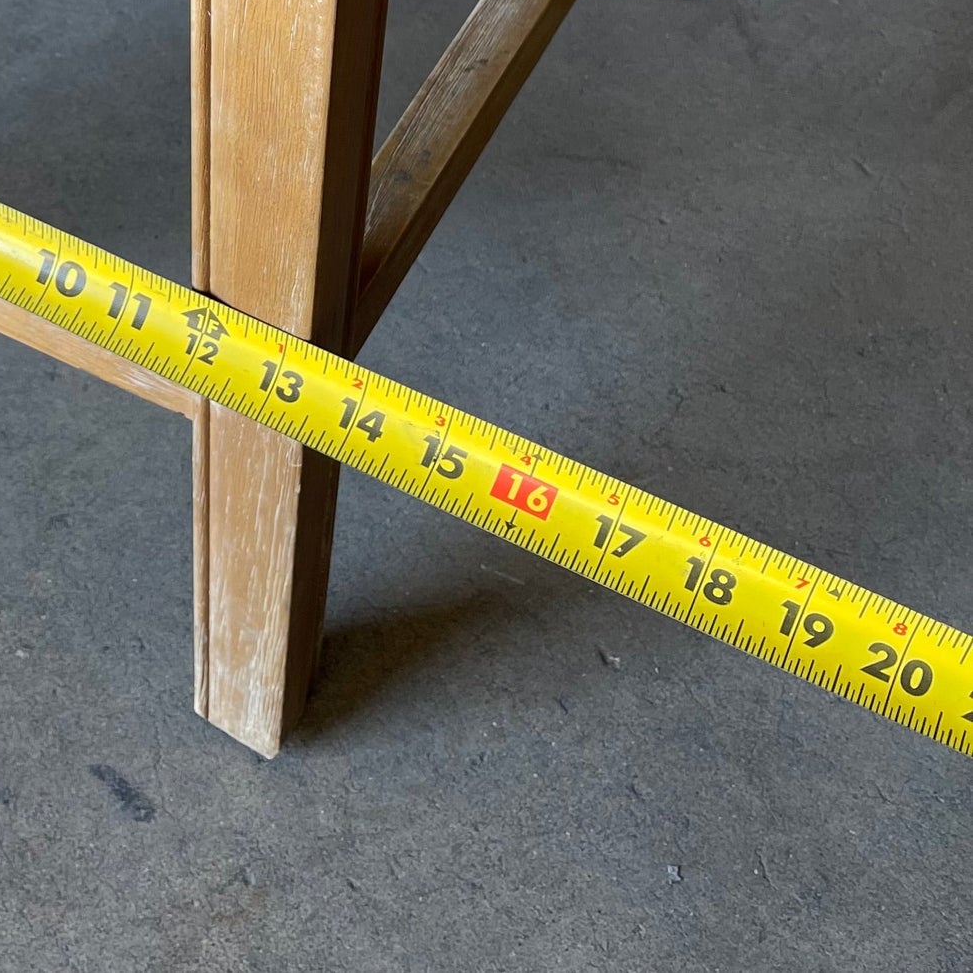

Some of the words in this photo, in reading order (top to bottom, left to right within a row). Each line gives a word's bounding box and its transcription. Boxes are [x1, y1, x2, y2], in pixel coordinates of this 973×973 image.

[36, 248, 87, 297] 10
[107, 282, 152, 331] 11
[185, 333, 219, 365] 12
[259, 360, 304, 403] 13
[339, 396, 386, 443] 14
[420, 435, 468, 479] 15
[504, 473, 549, 513] 16
[593, 514, 647, 558] 17
[684, 555, 737, 606] 18
[779, 599, 834, 648] 19
[860, 642, 933, 697] 20
[277, 343, 284, 354] 1
[352, 377, 363, 389] 2
[434, 415, 445, 427] 3
[520, 455, 532, 466] 4
[607, 494, 621, 505] 5
[699, 536, 712, 547] 6
[795, 577, 810, 589] 7
[892, 622, 908, 636] 8
